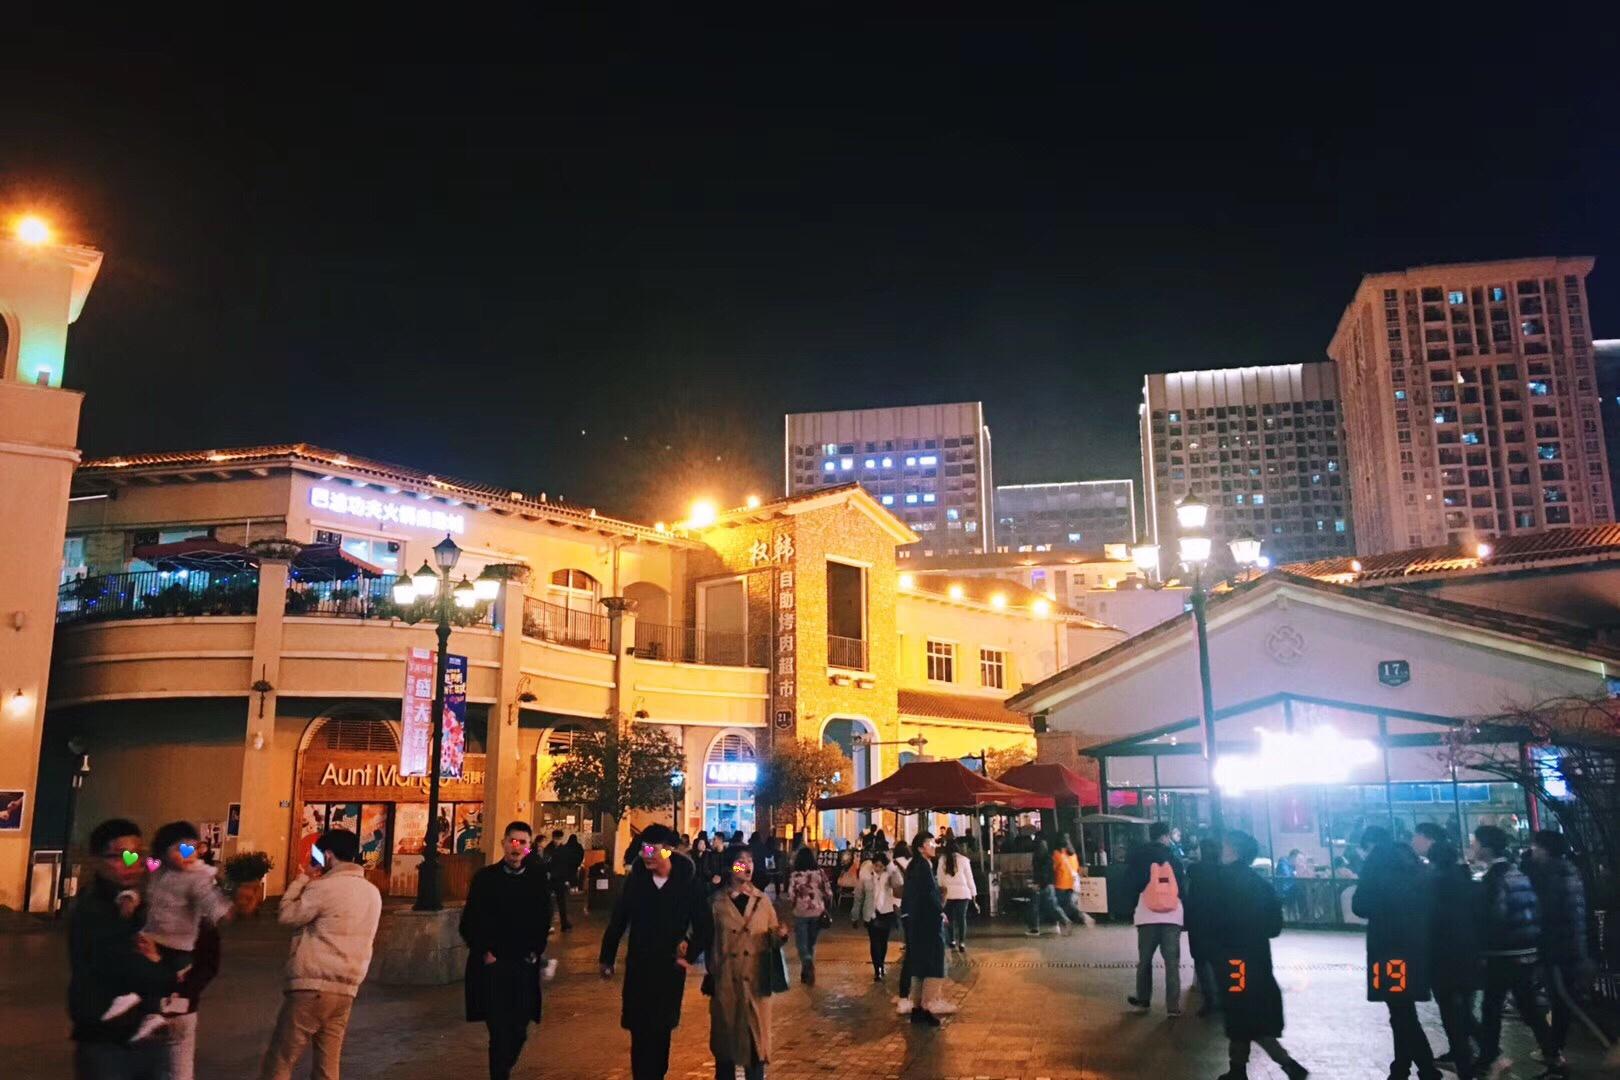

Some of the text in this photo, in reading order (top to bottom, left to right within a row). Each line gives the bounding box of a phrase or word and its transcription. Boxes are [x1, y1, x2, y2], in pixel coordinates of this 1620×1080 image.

[779, 571, 794, 698] 自助烤肉超市
[1384, 663, 1400, 676] 17
[777, 712, 786, 722] 21
[321, 763, 372, 786] Aunt
